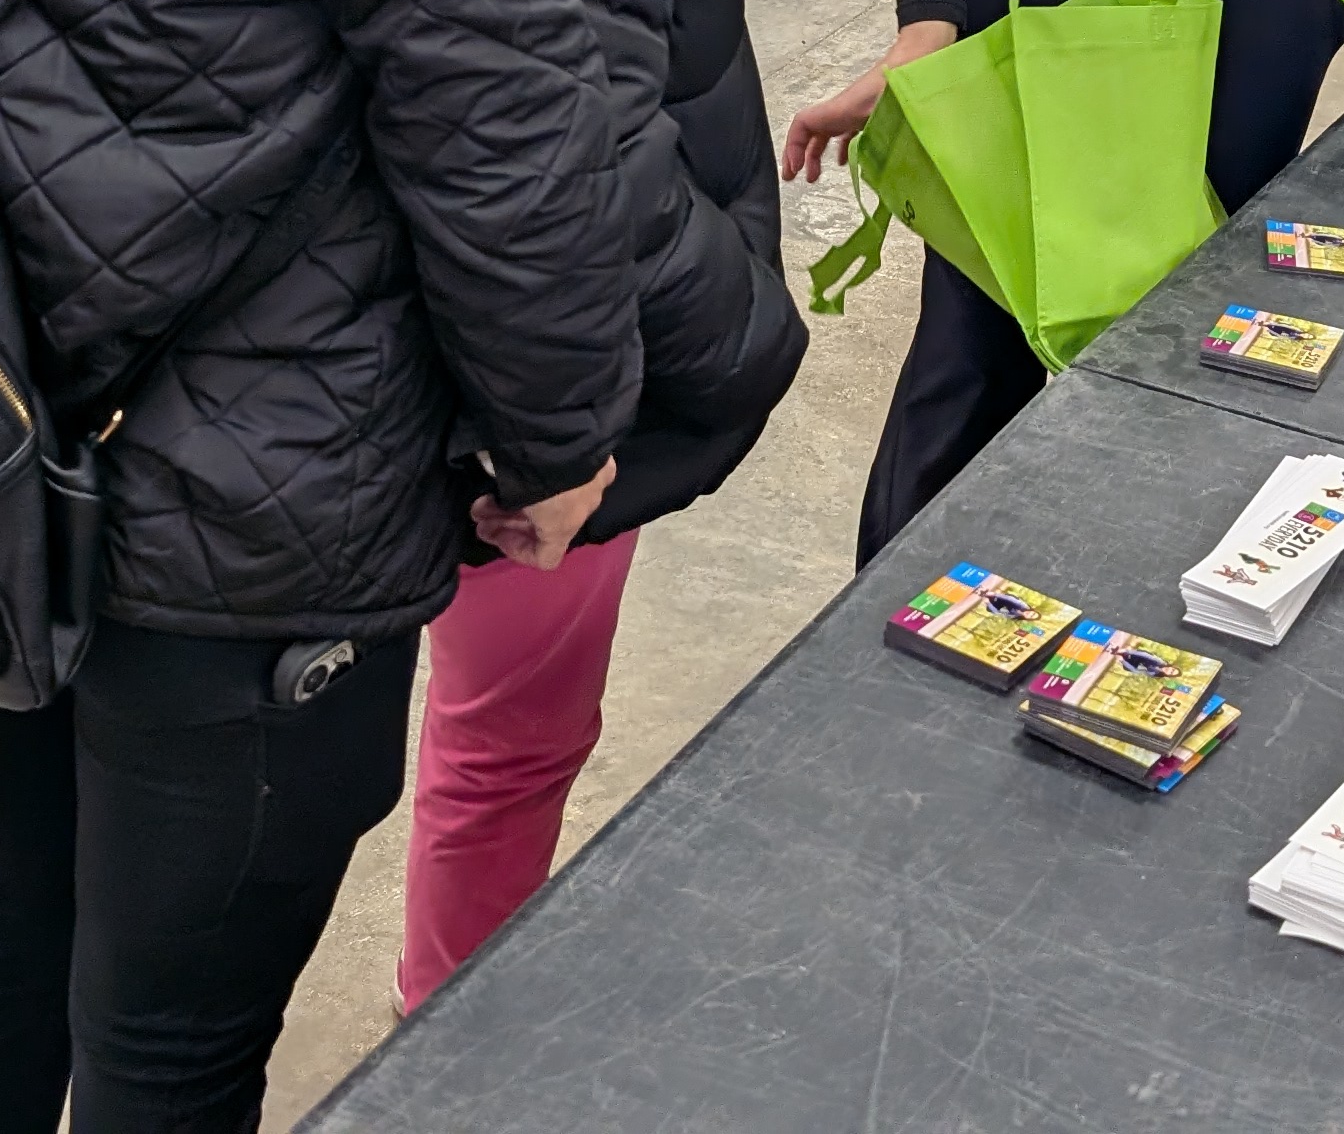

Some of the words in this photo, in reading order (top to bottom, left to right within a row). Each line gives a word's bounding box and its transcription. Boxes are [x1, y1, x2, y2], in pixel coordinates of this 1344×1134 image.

[1301, 352, 1321, 368] 5210
[1258, 519, 1304, 551] EVERYDAY
[1277, 526, 1325, 558] 5210
[996, 638, 1030, 664] 5210
[1151, 697, 1182, 727] 5210
